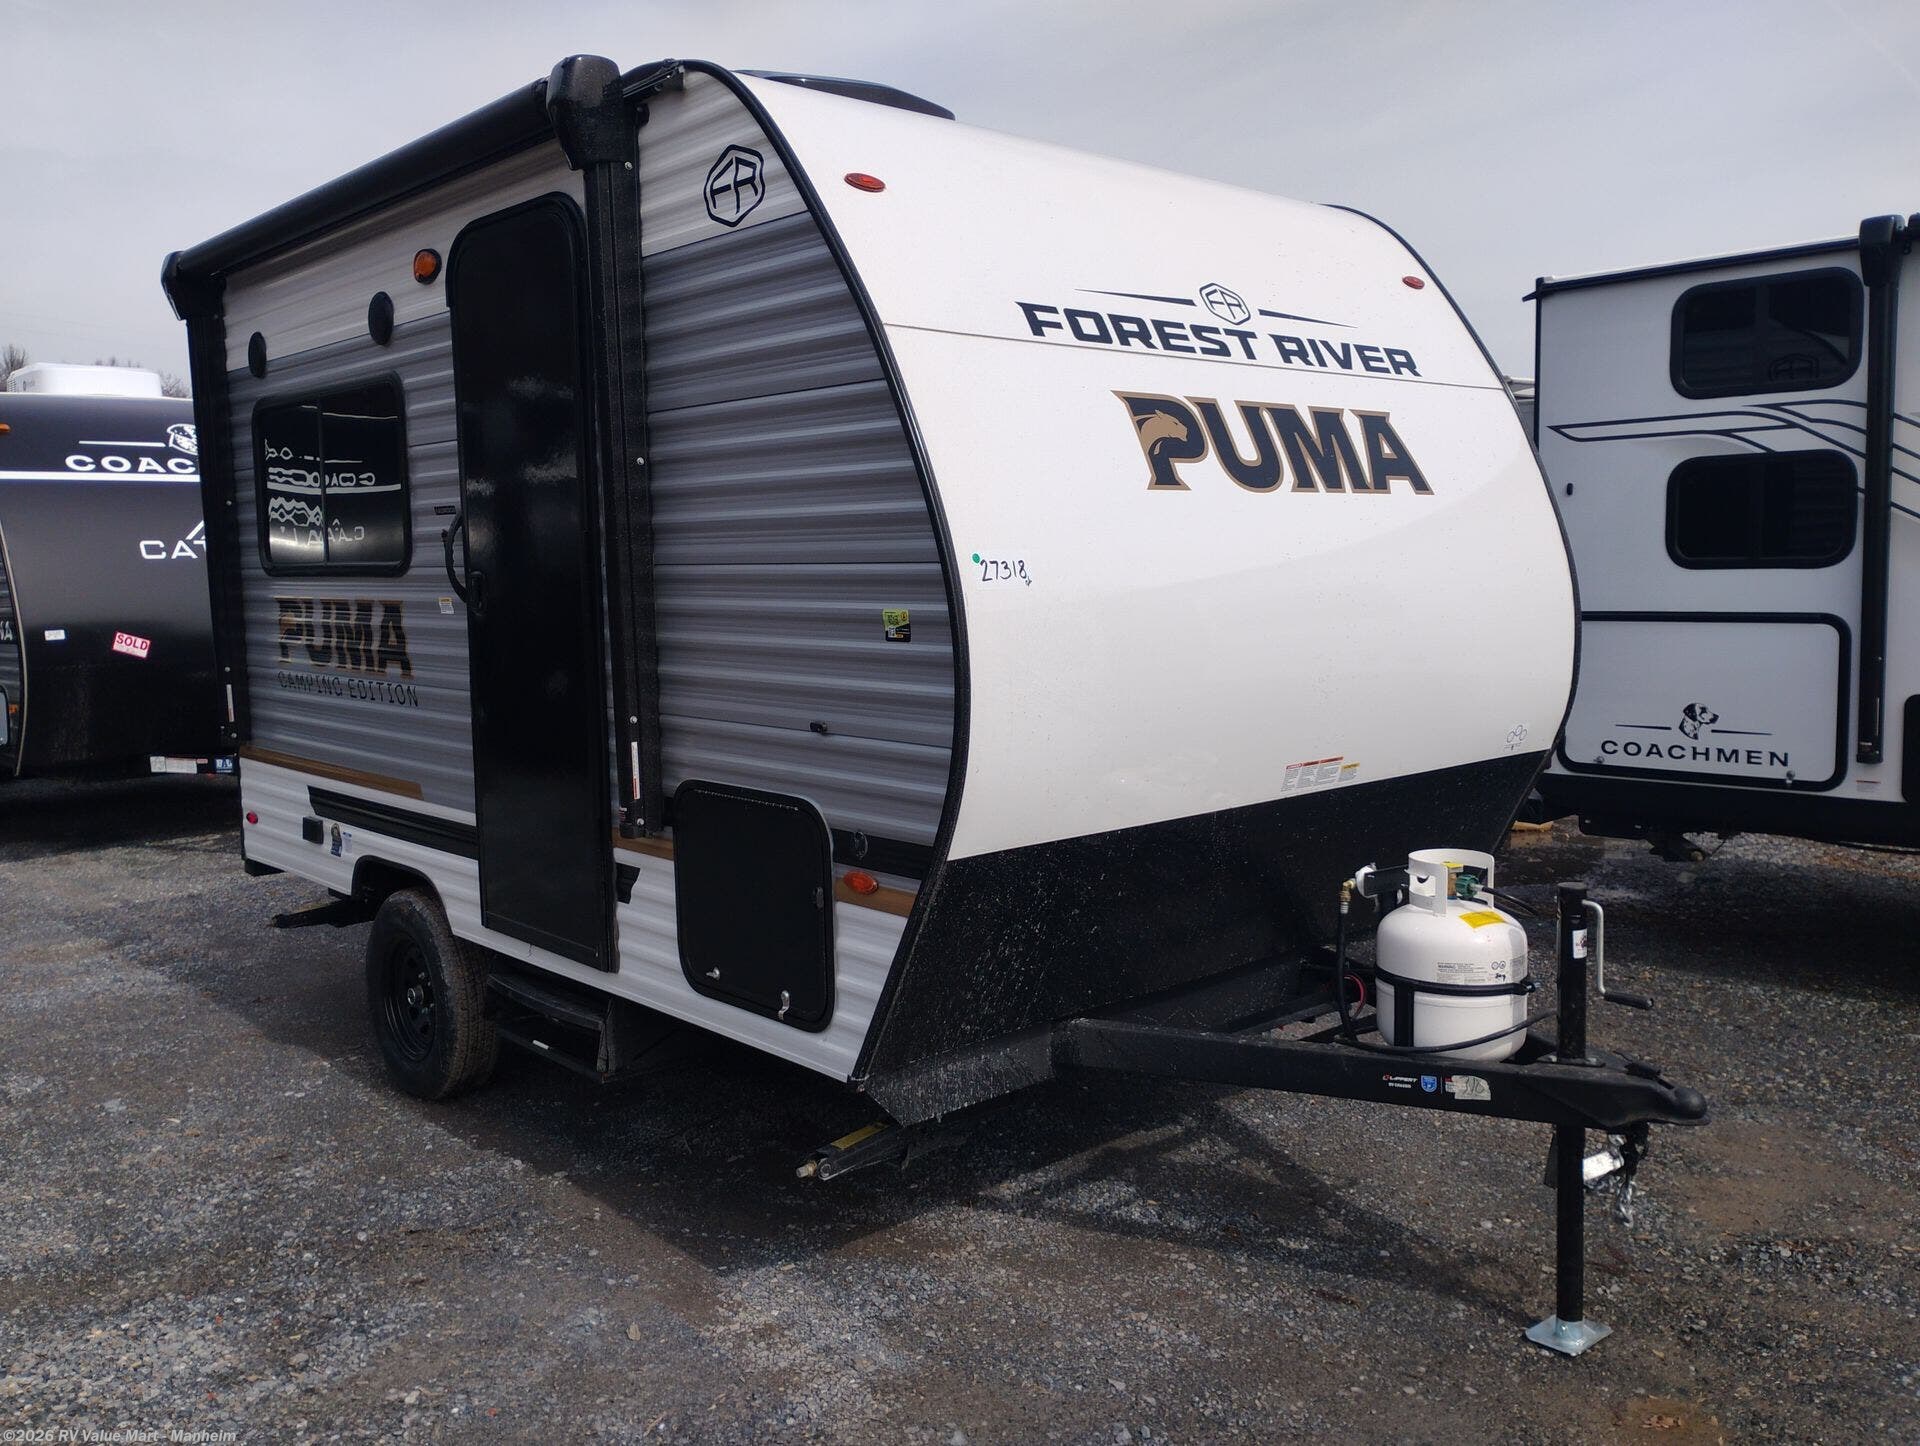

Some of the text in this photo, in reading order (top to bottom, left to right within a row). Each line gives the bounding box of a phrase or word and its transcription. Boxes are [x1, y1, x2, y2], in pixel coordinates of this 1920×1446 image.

[1014, 301, 1423, 377] FOREST RIVER
[1111, 390, 1434, 495] PUMA
[979, 559, 1028, 582] 27318
[116, 634, 148, 651] SOLD
[273, 595, 416, 681] PUMA
[277, 670, 419, 708] CAMPING EDITION
[1600, 740, 1789, 767] COACHMEN
